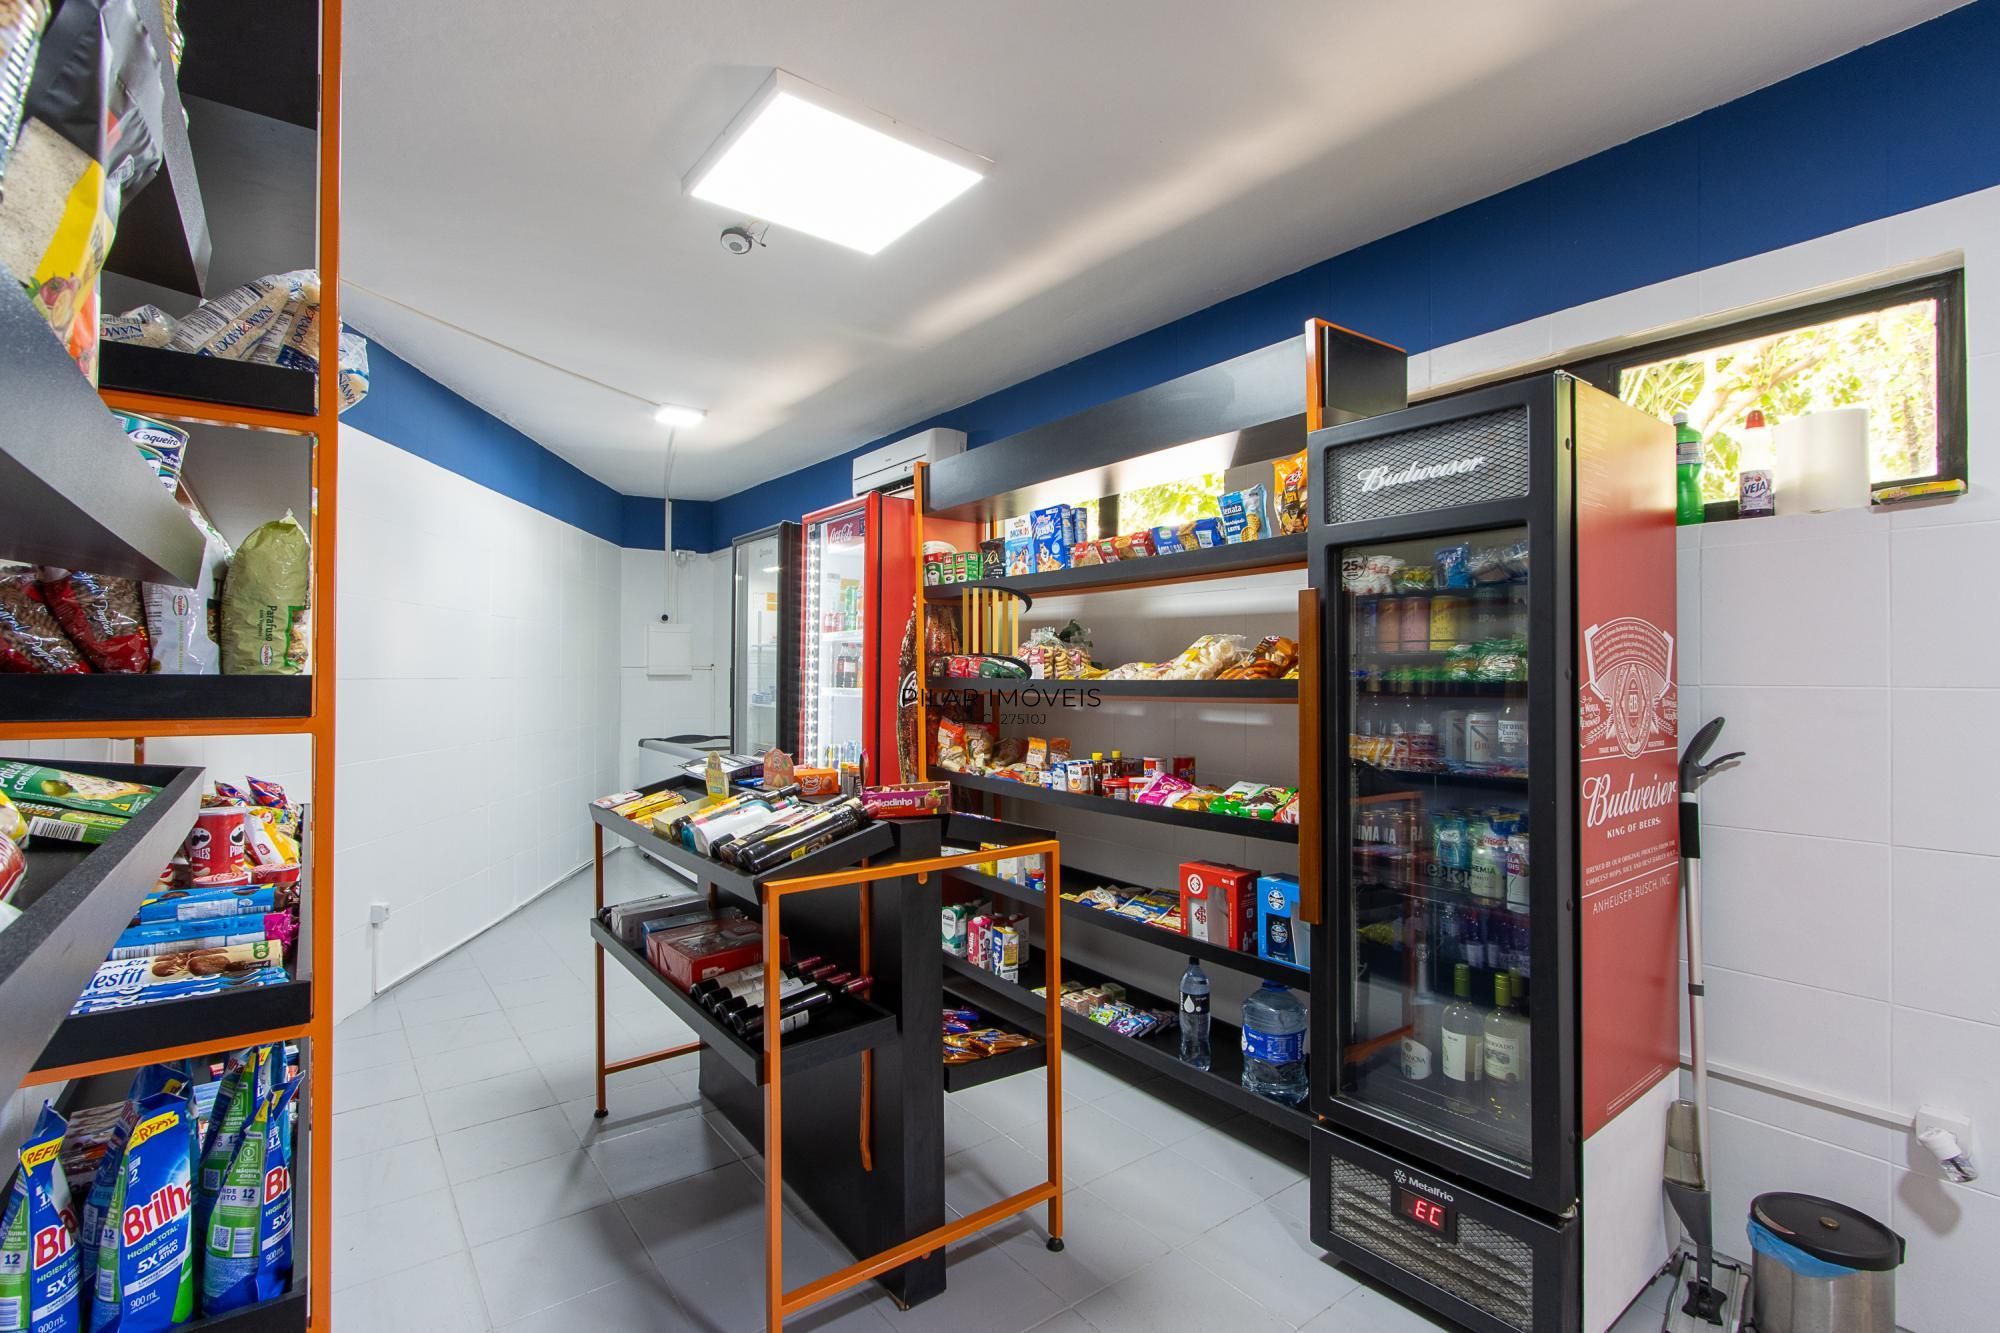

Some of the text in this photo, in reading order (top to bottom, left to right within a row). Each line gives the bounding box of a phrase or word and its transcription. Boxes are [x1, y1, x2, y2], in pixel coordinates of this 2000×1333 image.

[134, 431, 179, 447] Coqueiro
[1357, 456, 1486, 493] Budweiser
[1744, 481, 1766, 494] VEJA
[265, 604, 277, 642] Parafuso
[1582, 773, 1677, 828] Budweiser
[1606, 826, 1626, 839] KING
[1627, 822, 1637, 834] OF
[242, 1188, 255, 1200] 12
[1408, 1176, 1454, 1203] Metalfrio
[4, 1253, 21, 1266] 12
[127, 1239, 158, 1261] HIGIENE
[159, 1245, 179, 1262] ATIVO
[36, 1262, 69, 1284] HIGIENE
[137, 1253, 158, 1274] 5X
[46, 1276, 67, 1297] 5X
[130, 1295, 146, 1310] 900
[37, 1318, 54, 1333] 900
